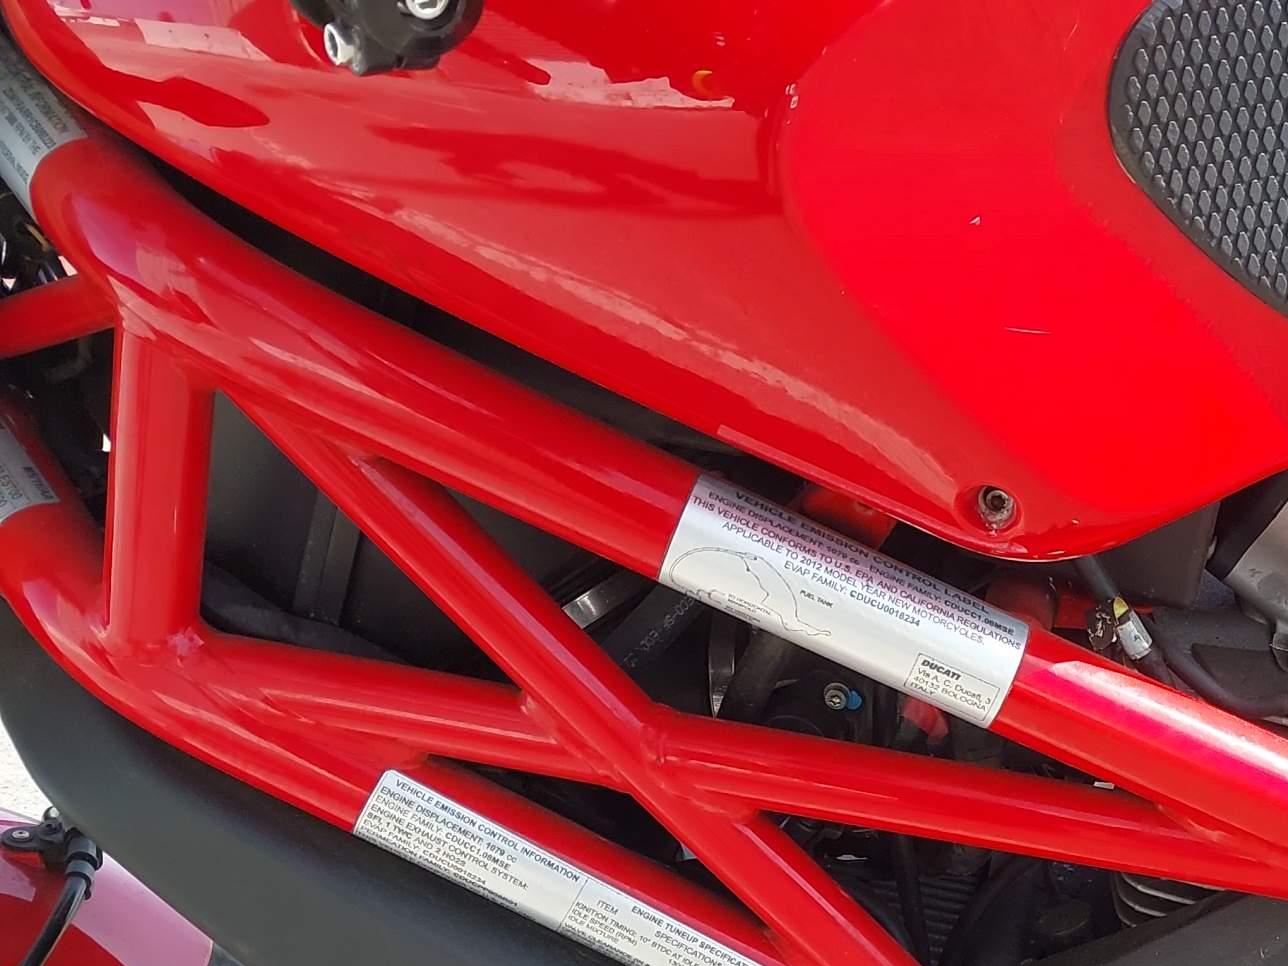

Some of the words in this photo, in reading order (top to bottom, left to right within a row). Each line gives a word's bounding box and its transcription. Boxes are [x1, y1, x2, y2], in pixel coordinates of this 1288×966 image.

[708, 491, 746, 513] ENGINE
[826, 546, 848, 559] 1079
[868, 564, 906, 586] ENGINE
[733, 490, 796, 524] VEHICLE
[799, 521, 870, 558] EMISSION
[871, 555, 942, 591] CONTROL
[943, 588, 990, 614] LABEL
[692, 496, 715, 511] THIS
[716, 506, 759, 531] VEHICLE
[759, 526, 818, 558] CONFORMS
[818, 553, 833, 565] TO
[833, 560, 854, 574] U.S.
[854, 569, 874, 583] EPA
[876, 579, 898, 594] AND
[898, 589, 956, 621] CALIFORNIA
[955, 615, 1022, 650] REGULATIONS
[722, 520, 783, 554] APPLICABLE
[783, 548, 799, 560] TO
[799, 555, 823, 571] 2012
[823, 566, 858, 587] MODEL
[858, 582, 887, 600] YEAR
[886, 594, 911, 611] NEW
[910, 605, 986, 645] MOTORCYCLES.
[783, 560, 810, 578] EVAP
[810, 572, 848, 594] FAMILY:
[799, 588, 815, 600] FUEL
[816, 596, 834, 608] TANK
[909, 681, 934, 696] ITALY
[916, 667, 931, 678] Via
[953, 683, 984, 702] Ducati,
[984, 697, 991, 705] 3
[920, 658, 961, 681] DUCATI
[912, 674, 940, 691] 40132
[940, 686, 987, 712] BOLOGNA
[375, 794, 410, 817] ENGINE
[410, 812, 443, 835] FAMILY:
[379, 785, 415, 809] ENGINE
[485, 841, 505, 857] 1079
[505, 853, 517, 863] cc
[394, 778, 434, 804] VEHICLE
[433, 799, 477, 827] EMISSION
[476, 822, 521, 851] CONTROL
[519, 845, 580, 883] INFORMATION
[362, 818, 386, 834] EVAP
[387, 830, 421, 852] FAMILY:
[370, 802, 405, 826] ENGINE
[405, 821, 448, 849] EXHAUST
[447, 843, 491, 871] CONTROL
[490, 865, 529, 891] SYSTEM:
[391, 824, 412, 839] TWC
[413, 835, 433, 850] AND
[571, 907, 588, 920] IDLE
[589, 916, 615, 934] SPEED
[614, 930, 638, 947] (RPM)
[596, 899, 618, 915] ITEM
[631, 905, 664, 927] ENGINE
[663, 921, 699, 945] TUNEUP
[567, 913, 585, 926] IDLE
[585, 922, 619, 944] MIXTURE
[574, 900, 609, 922] IGNITION
[650, 940, 672, 956] BTDC
[671, 950, 682, 961] AT
